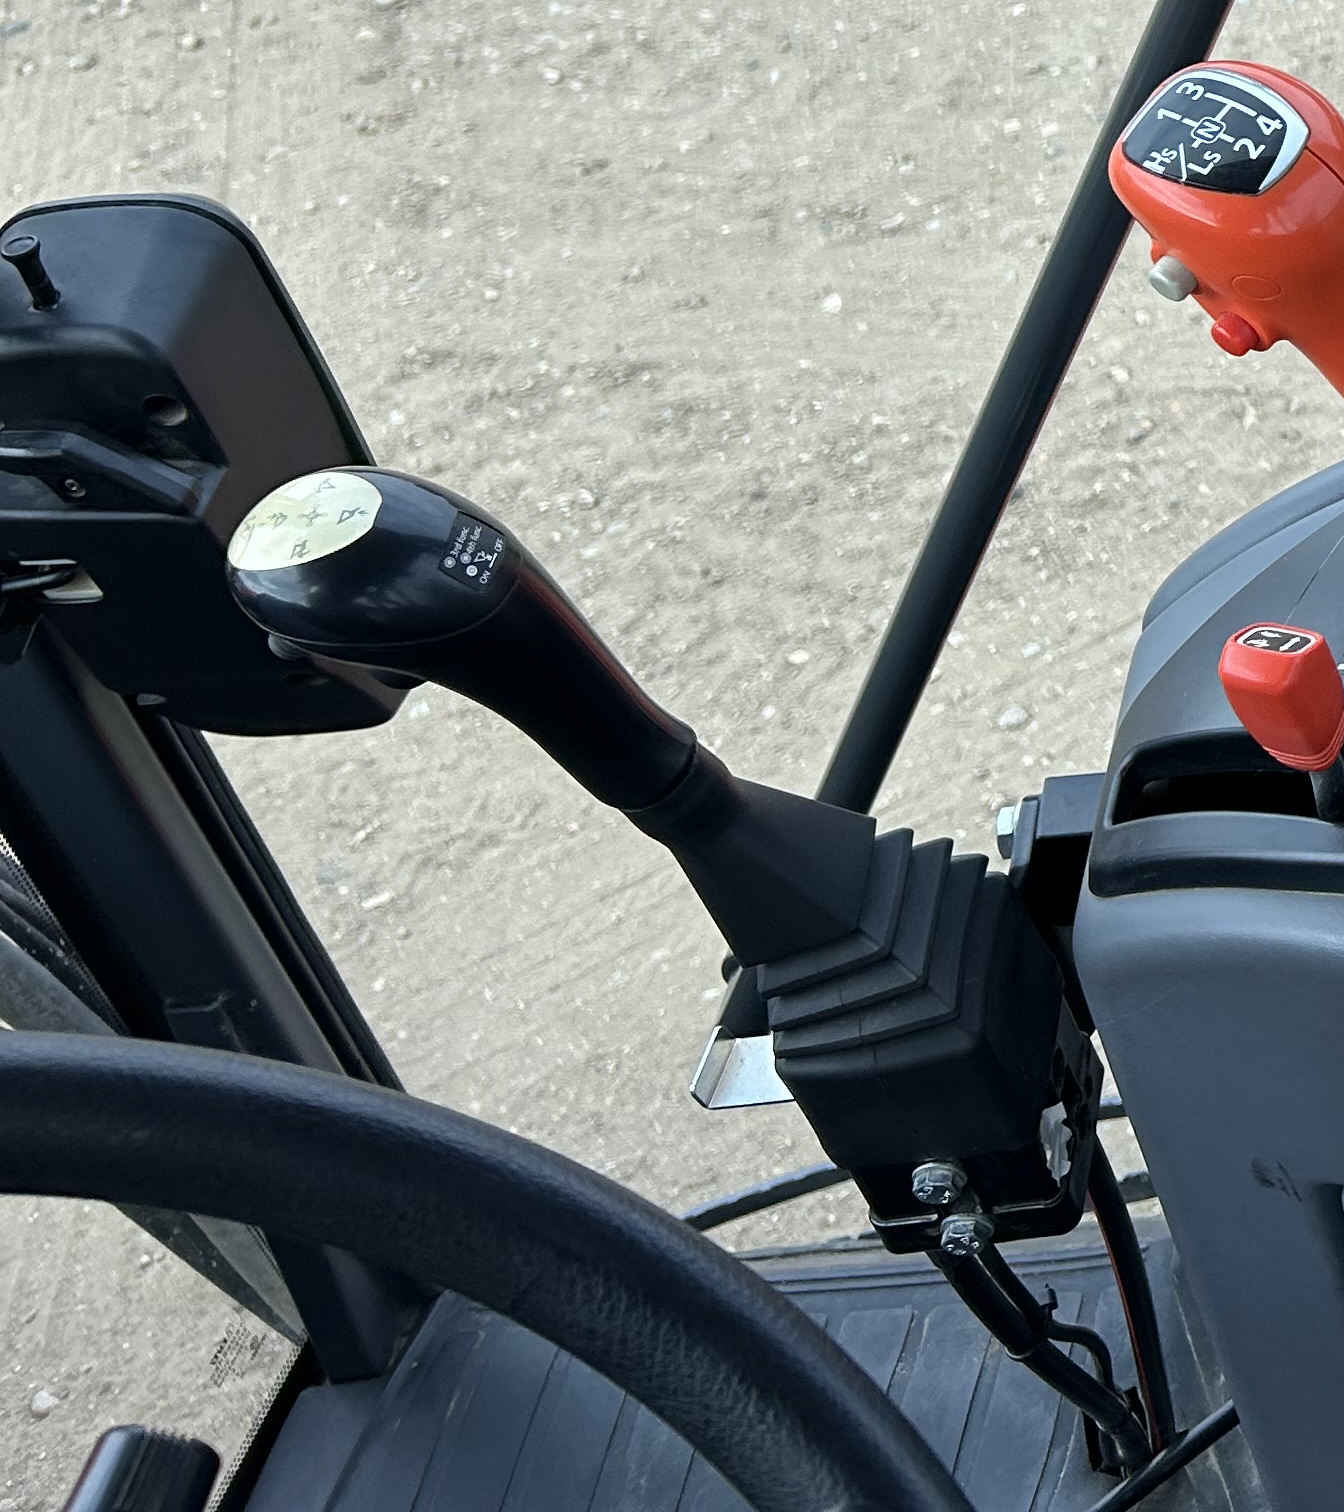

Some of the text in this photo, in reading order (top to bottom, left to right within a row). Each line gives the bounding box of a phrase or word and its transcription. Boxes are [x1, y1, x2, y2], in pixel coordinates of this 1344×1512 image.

[1176, 81, 1205, 101] 3
[1157, 107, 1183, 121] 1
[1198, 121, 1220, 140] N
[1256, 114, 1285, 136] 4
[1233, 138, 1266, 160] 2
[494, 537, 504, 553] OFF
[479, 570, 491, 584] ON
